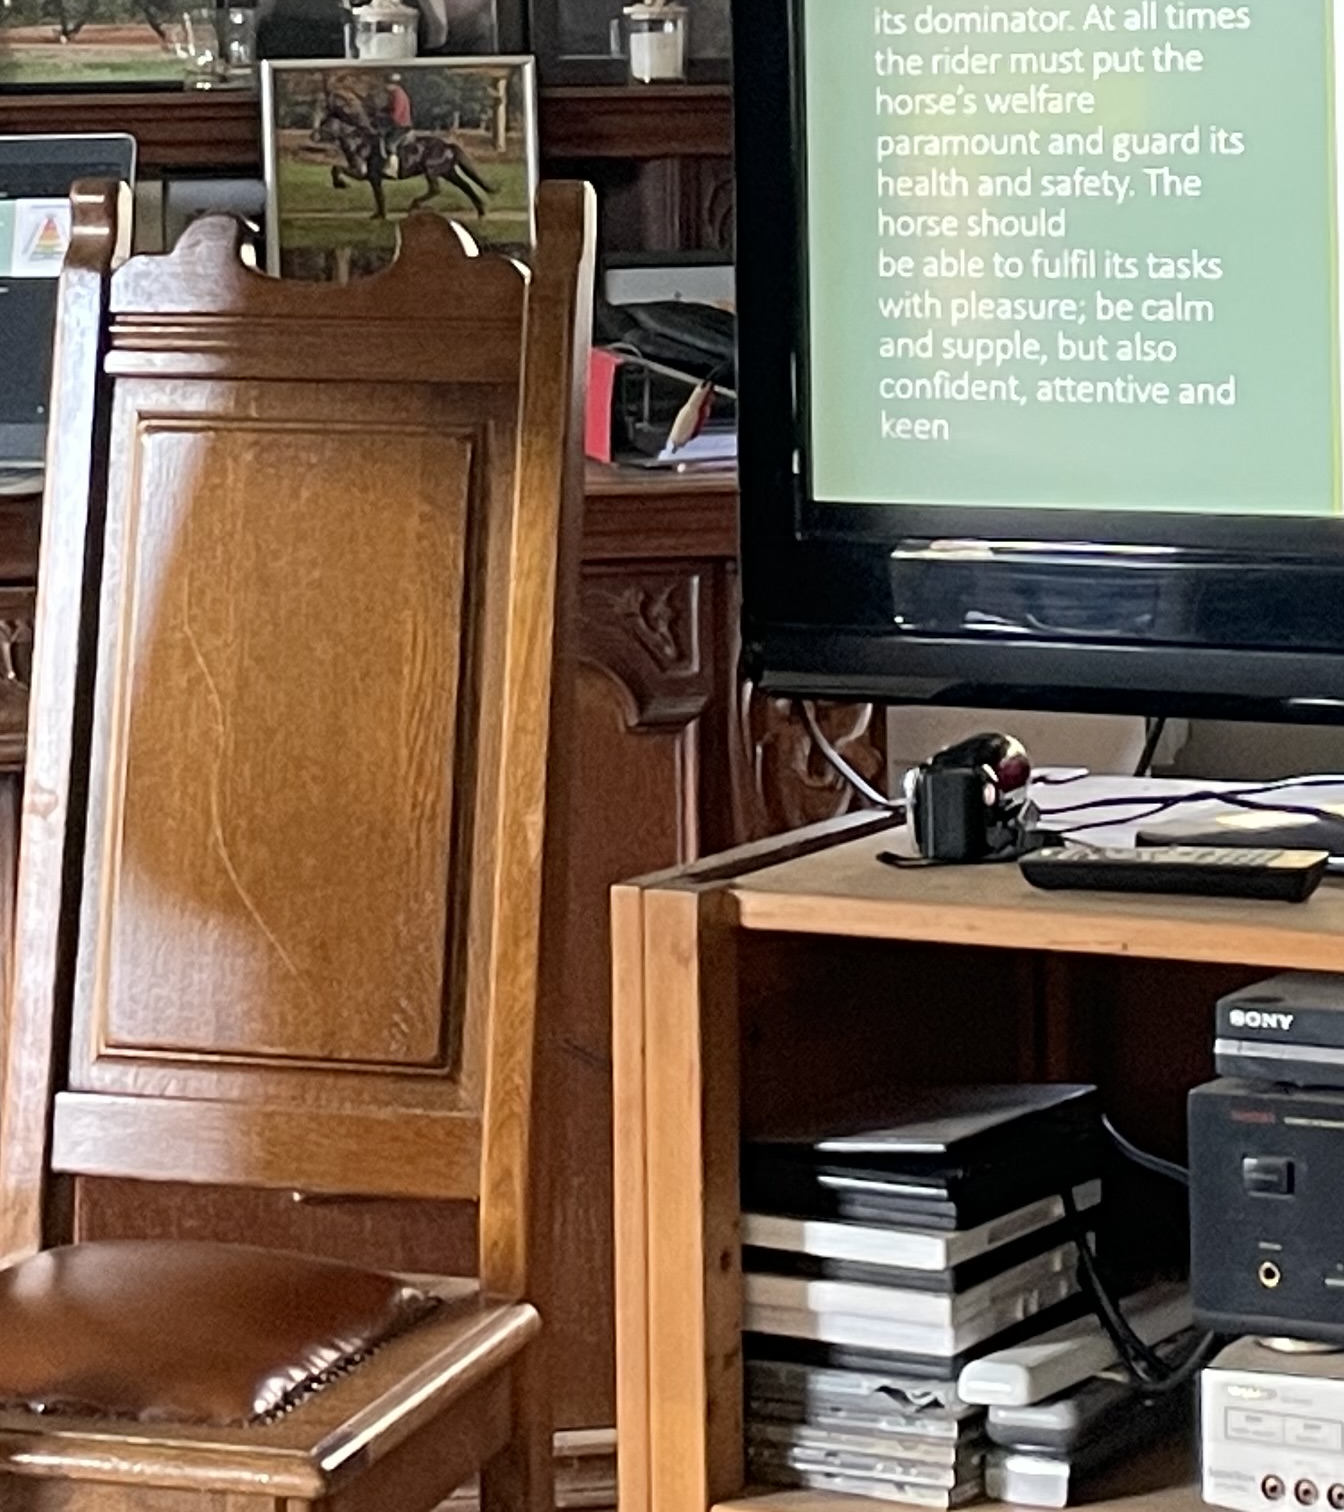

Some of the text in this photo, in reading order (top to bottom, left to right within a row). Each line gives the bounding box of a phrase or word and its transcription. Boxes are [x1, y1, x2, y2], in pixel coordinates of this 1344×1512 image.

[874, 0, 1251, 35] its dominator. At all times
[874, 41, 1204, 81] the rider must put the
[875, 83, 1095, 116] horse's welfare
[876, 124, 1245, 164] paramount and guard its
[877, 166, 1202, 205] health and safety. The
[877, 207, 1066, 238] horse should
[878, 247, 1224, 280] be able to fulfil its tasks
[878, 289, 1214, 327] with pleasure; be calm
[879, 328, 1177, 368] and supple, but also
[879, 369, 1236, 406] confident, attentive and
[881, 409, 950, 441] keen
[1229, 1009, 1293, 1030] SONY
